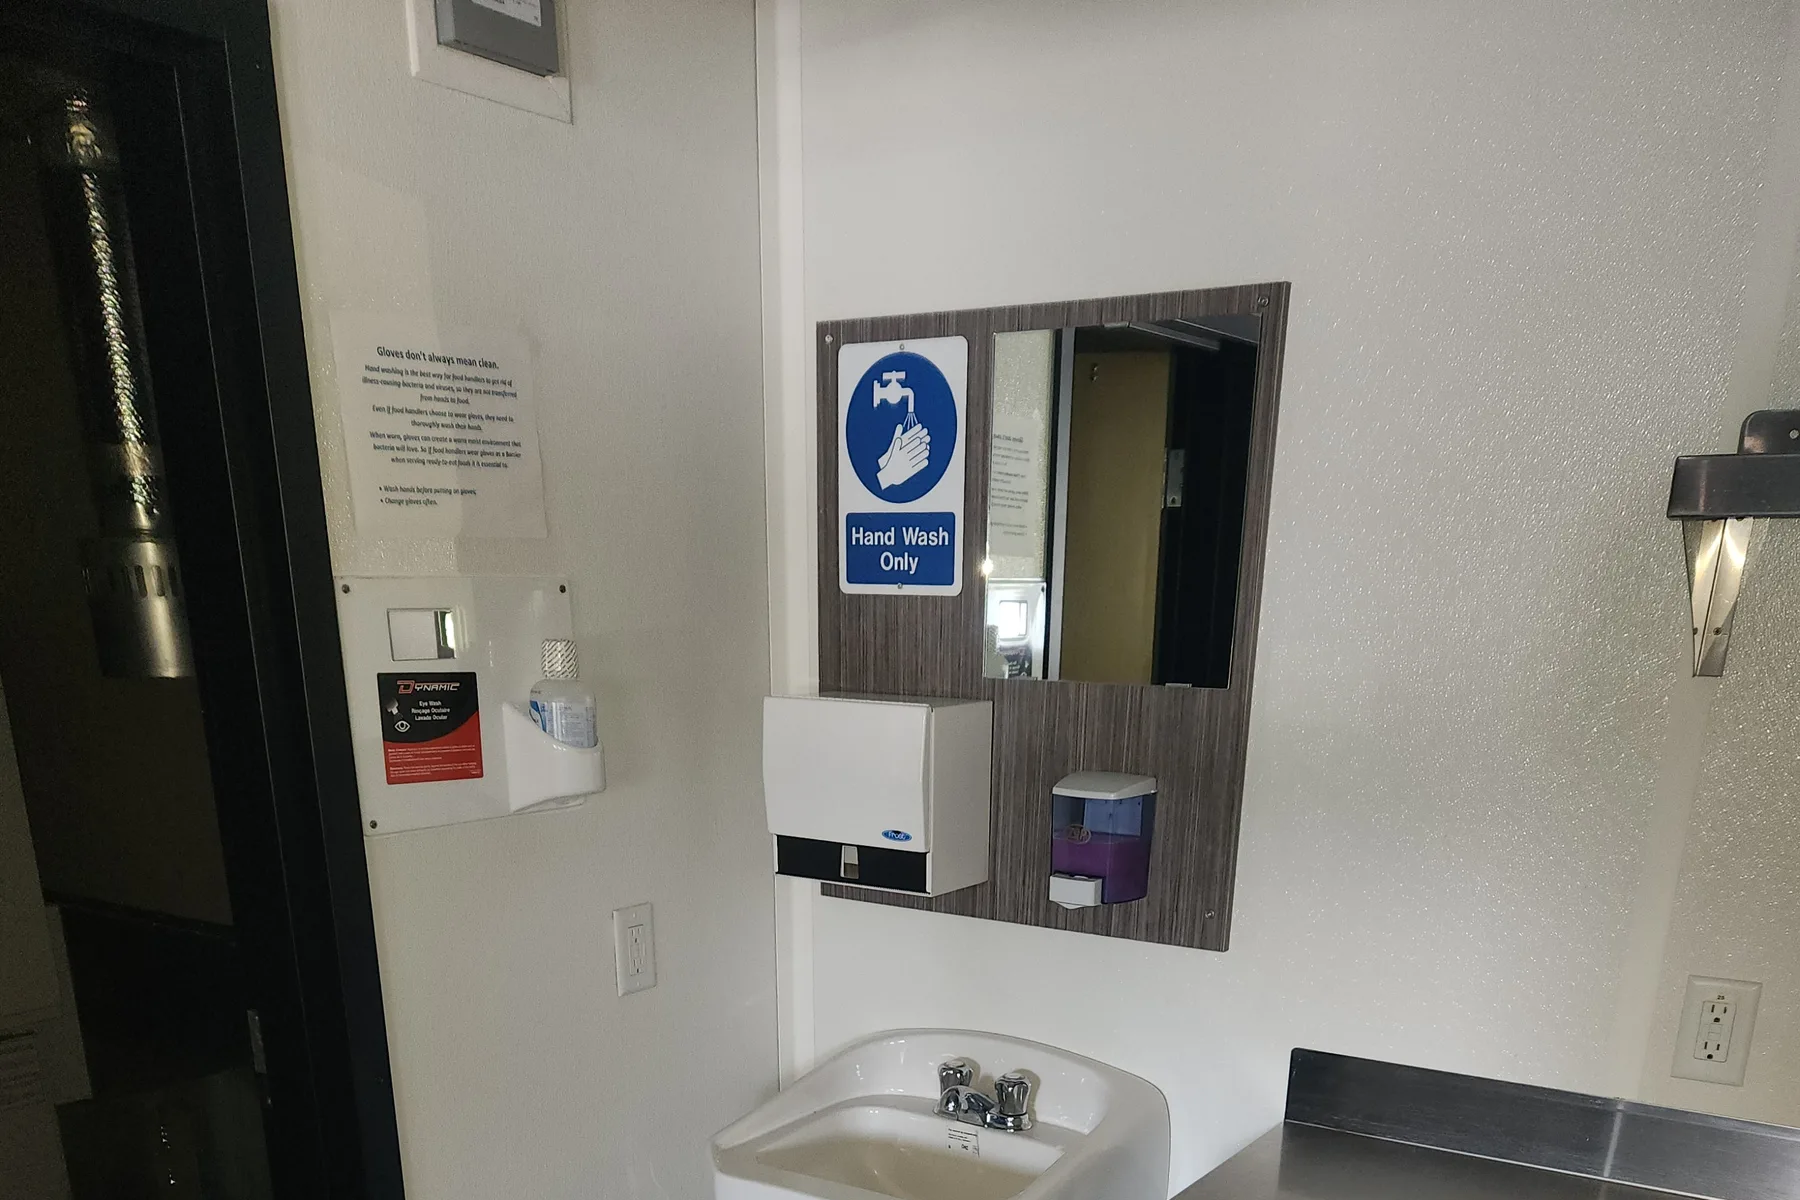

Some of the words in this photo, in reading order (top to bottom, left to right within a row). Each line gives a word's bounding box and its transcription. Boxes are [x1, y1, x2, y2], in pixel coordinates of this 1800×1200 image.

[377, 346, 404, 358] Gloves
[406, 350, 426, 361] don't
[428, 353, 454, 365] always
[457, 357, 477, 366] mean
[479, 358, 499, 369] clean.
[381, 366, 403, 376] washing
[452, 374, 463, 382] food
[465, 375, 485, 383] handlers
[362, 376, 401, 388] illness-causing
[402, 381, 423, 389] bacteria
[463, 387, 473, 395] they
[420, 394, 432, 402] from
[391, 405, 404, 415] food
[405, 407, 428, 416] handlers
[429, 409, 446, 417] choose
[485, 414, 495, 422] they
[411, 420, 440, 429] thoroughly
[369, 431, 386, 439] When
[403, 434, 420, 442] gloves
[373, 443, 395, 451] bacteria
[407, 445, 419, 453] love.
[433, 446, 444, 454] food
[384, 485, 398, 493] Wash
[416, 486, 433, 495] before
[384, 497, 404, 506] Change
[406, 498, 422, 506] gloves
[852, 526, 895, 546] Hand
[902, 526, 949, 546] Wash
[880, 551, 919, 575] Only
[397, 680, 460, 694] DYNAMIC
